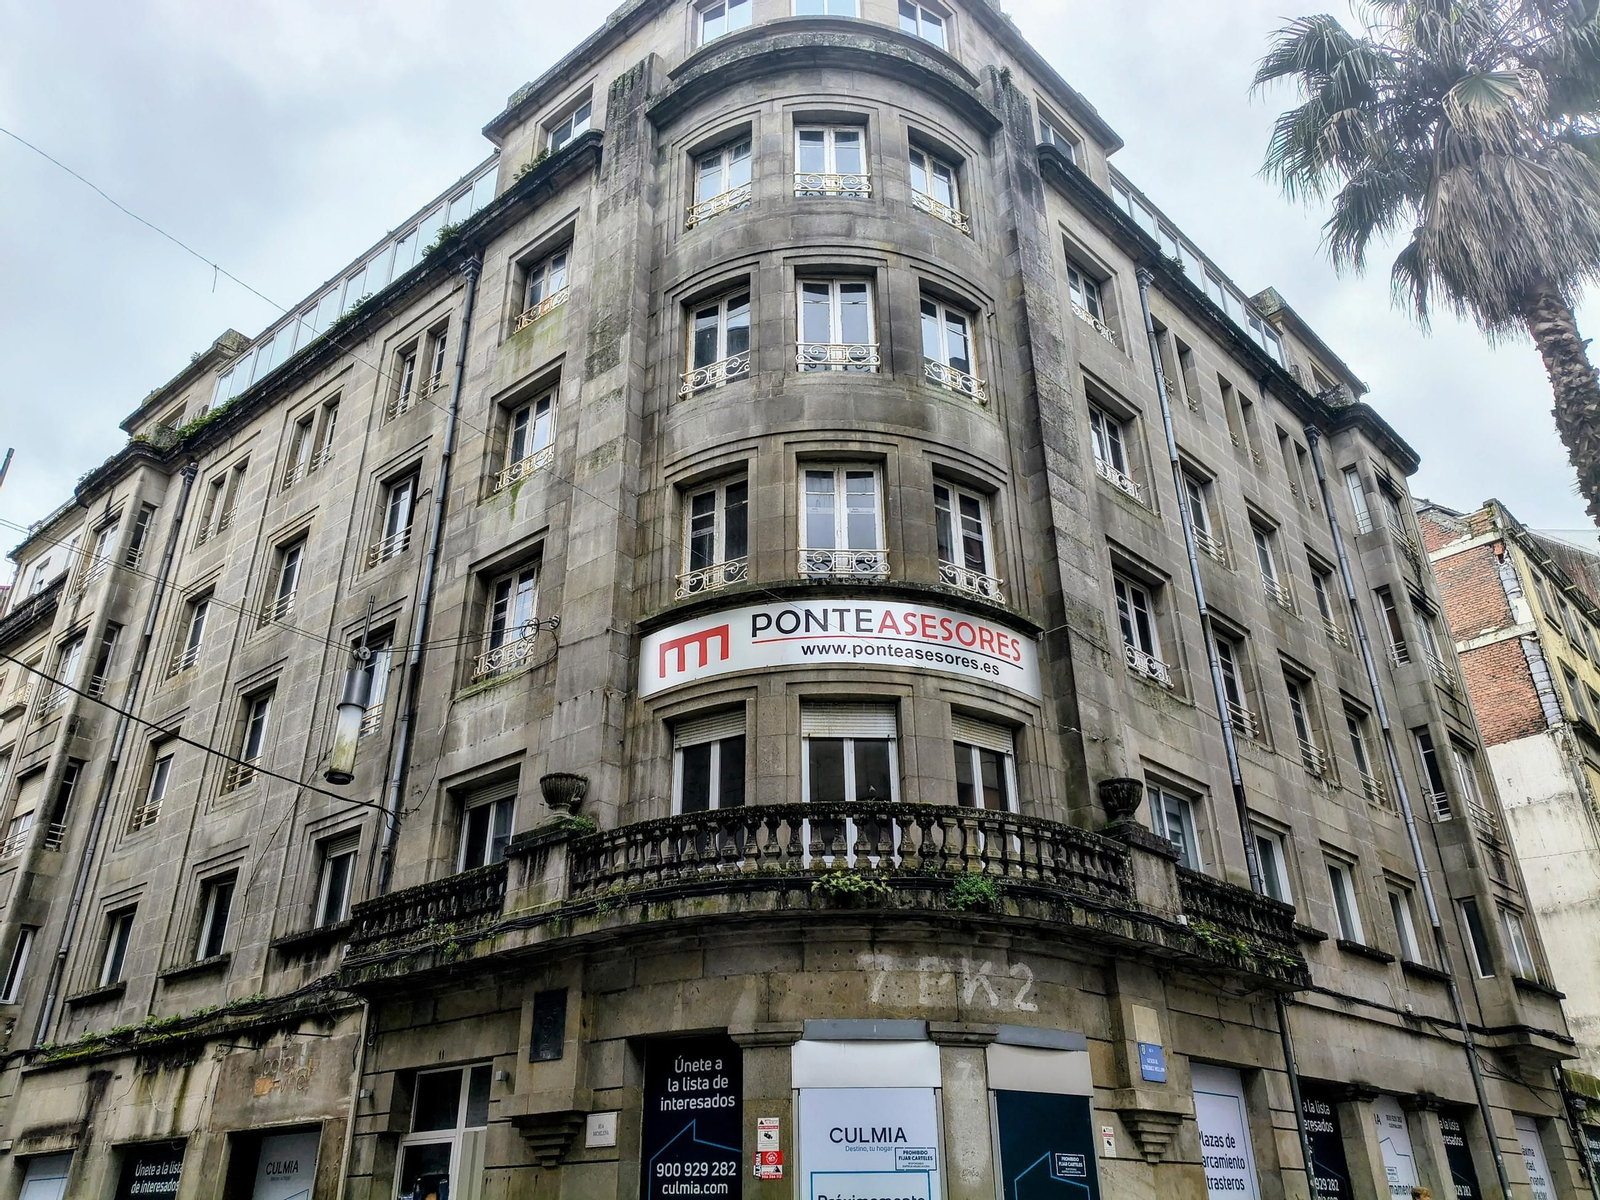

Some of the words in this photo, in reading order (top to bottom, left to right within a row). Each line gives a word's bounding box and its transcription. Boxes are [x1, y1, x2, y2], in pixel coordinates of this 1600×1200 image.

[751, 608, 1021, 662] PONTEASESORES
[801, 643, 1000, 676] www.ponteasesores.es
[674, 1055, 712, 1073] Únete
[715, 1059, 723, 1070] a
[667, 1077, 679, 1092] la
[682, 1076, 710, 1091] lista
[713, 1074, 729, 1089] de
[660, 1093, 736, 1111] interesados
[1303, 1119, 1334, 1133] eresados
[828, 1127, 908, 1144] CULMIA
[1198, 1131, 1225, 1148] lazas
[1225, 1133, 1236, 1149] de
[876, 1145, 893, 1153] hogar
[135, 1159, 156, 1177] Únete
[155, 1165, 161, 1176] a
[161, 1161, 169, 1175] la
[265, 1160, 299, 1175] CULMIA
[656, 1162, 681, 1178] 900
[684, 1162, 709, 1177] 929
[711, 1161, 737, 1177] 282
[1202, 1153, 1246, 1170] arcamiento
[131, 1180, 141, 1194] de
[661, 1180, 729, 1195] culmia.com
[1206, 1174, 1246, 1191] trasteros
